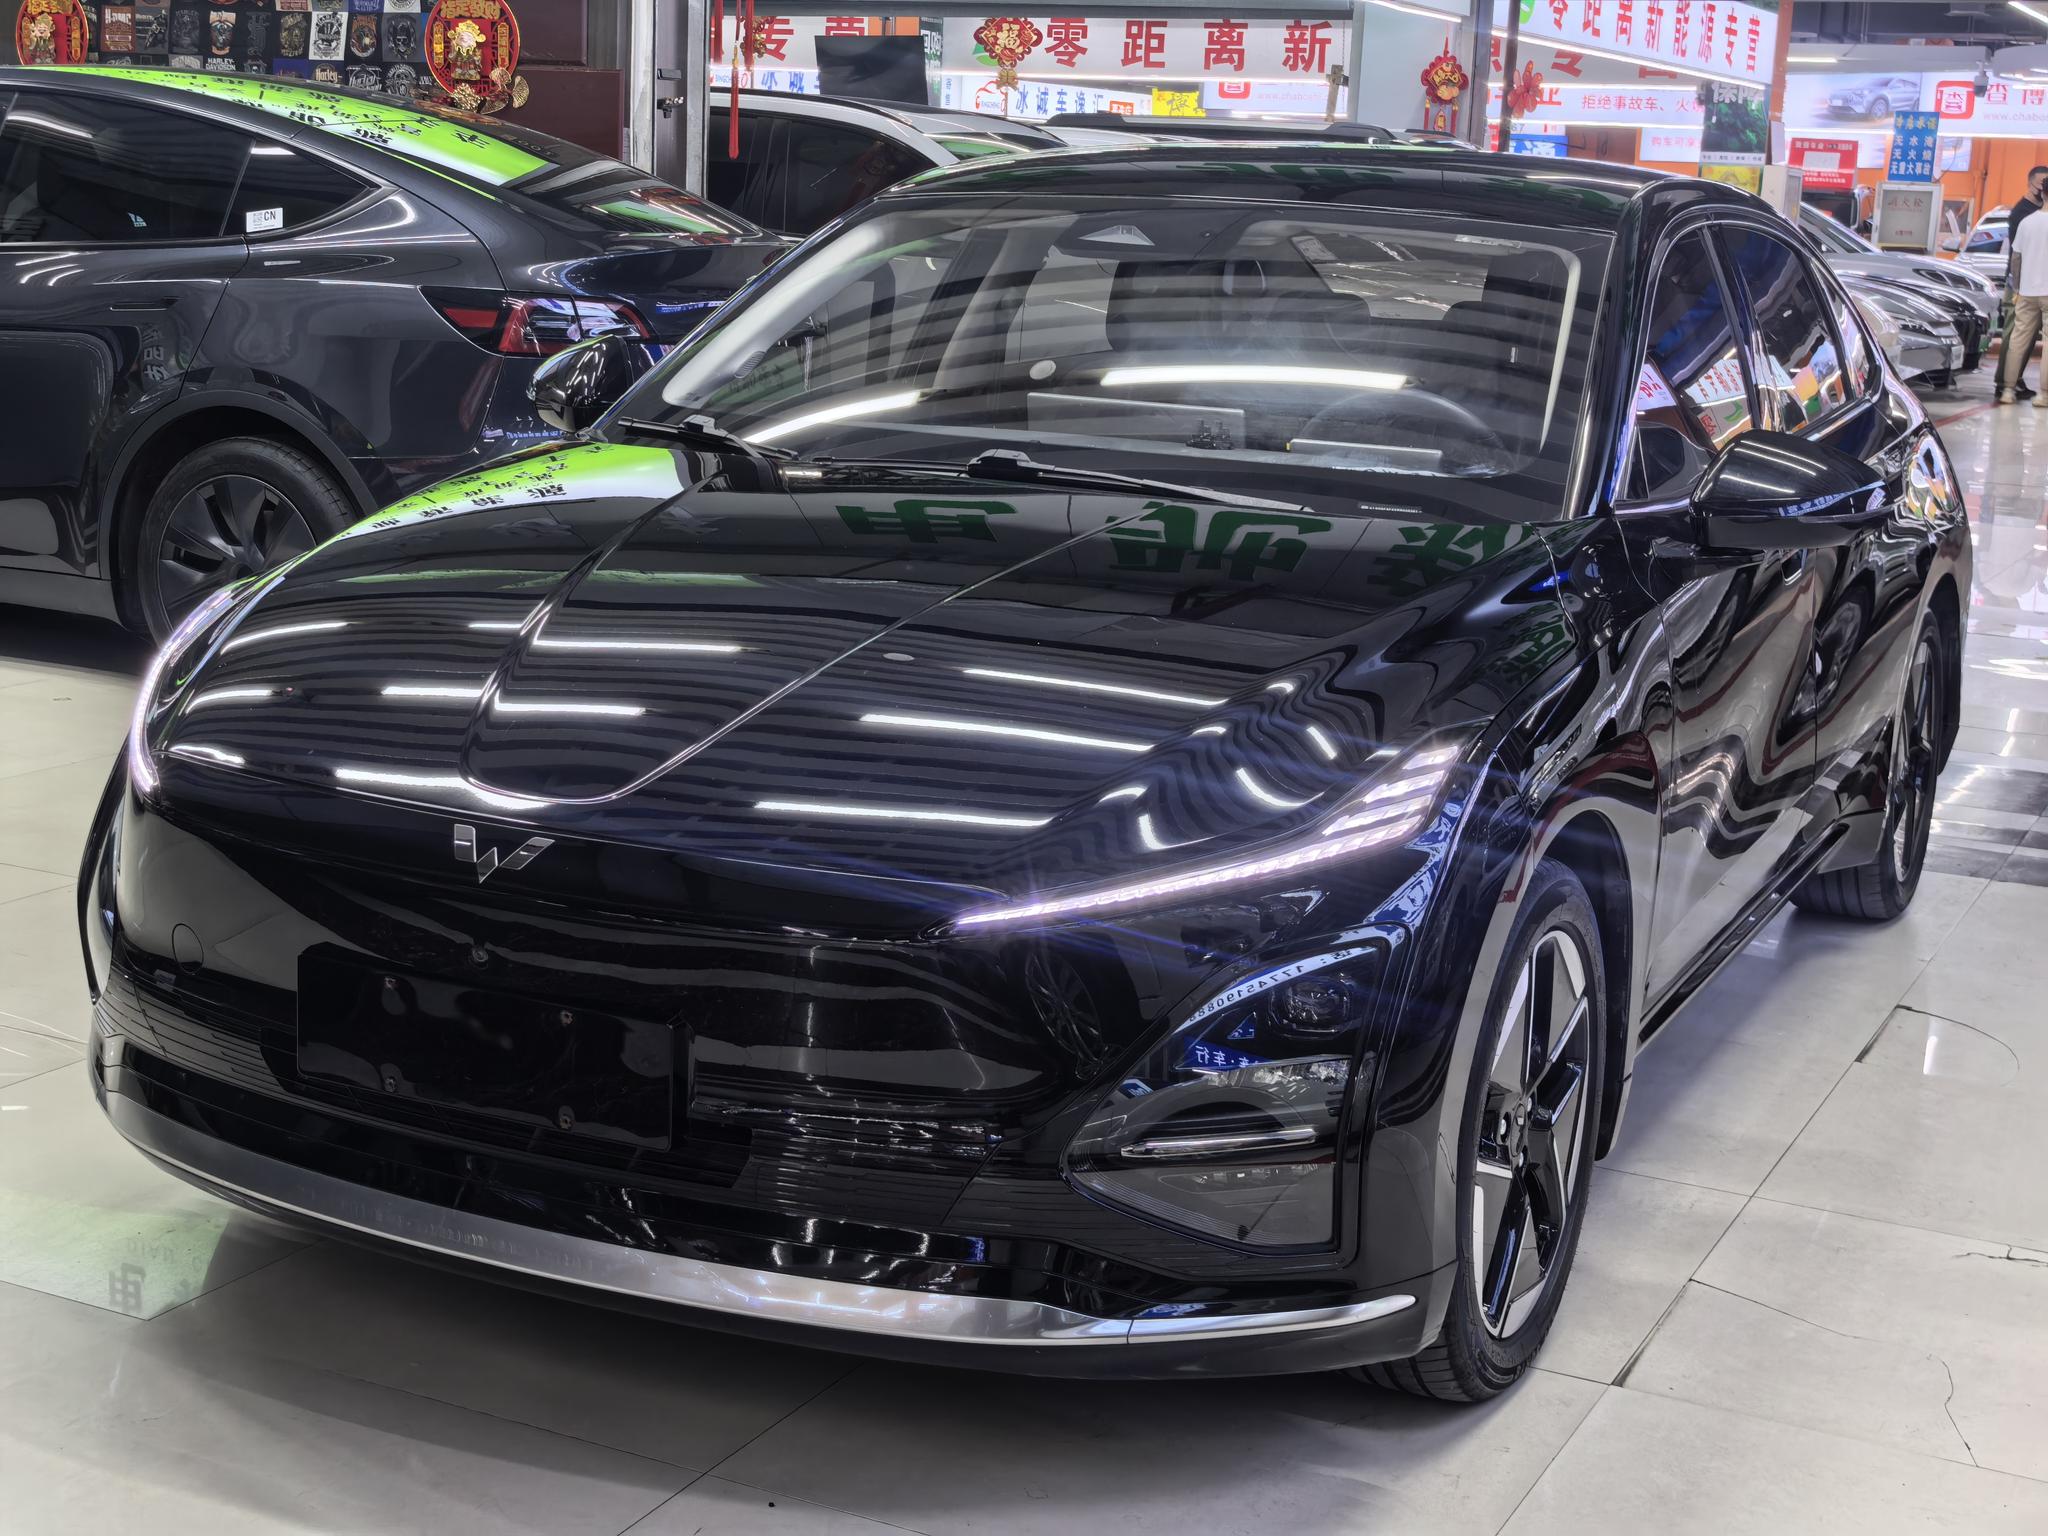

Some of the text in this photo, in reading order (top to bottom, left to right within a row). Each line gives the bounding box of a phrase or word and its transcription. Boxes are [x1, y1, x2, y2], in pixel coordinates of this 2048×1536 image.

[1045, 18, 1333, 73] 零距离新
[264, 211, 276, 221] CN
